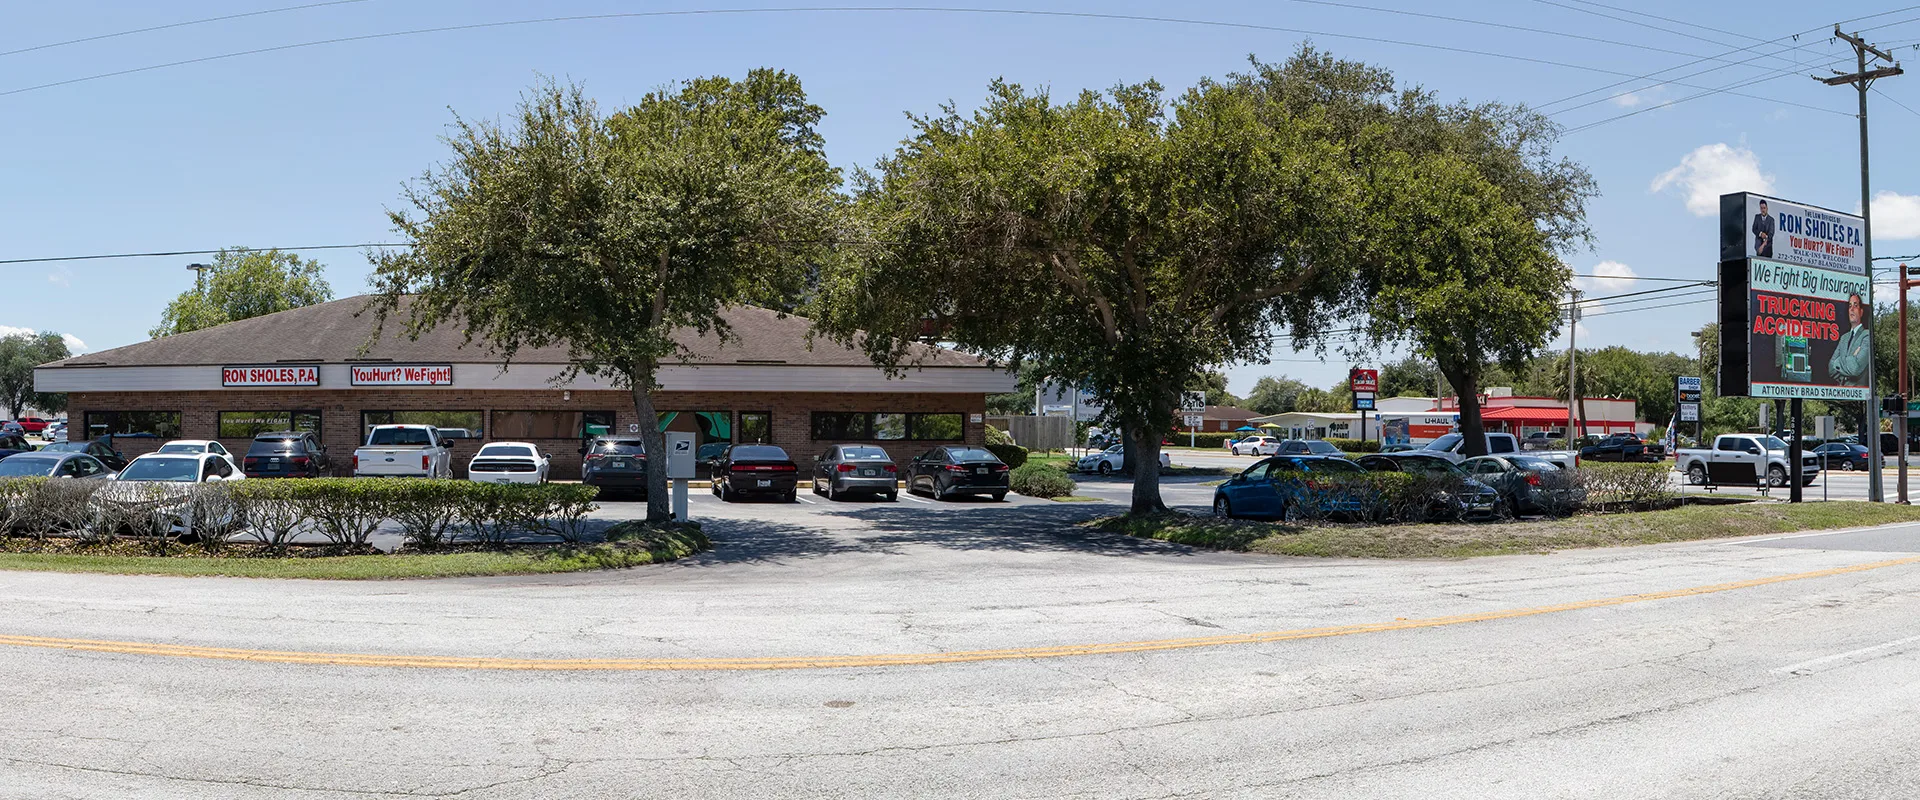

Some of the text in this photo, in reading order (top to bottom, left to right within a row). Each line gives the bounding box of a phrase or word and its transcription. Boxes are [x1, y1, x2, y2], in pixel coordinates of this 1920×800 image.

[1780, 212, 1863, 247] RON SHOLES P.A.
[1789, 235, 1855, 258] YOU HURT? WE FIGHT!
[1793, 248, 1850, 264] WALK-INS WELCOME
[1818, 258, 1847, 270] BLANDING
[1848, 264, 1862, 272] BLVD
[1754, 263, 1868, 297] We Fight Big Insurance!
[1757, 294, 1836, 321] TRUCKING
[1753, 315, 1839, 342] ACCIDENTS
[223, 368, 319, 385] RON SHOLES, P.A.
[353, 367, 451, 385] YouHurt? WeFight!
[1679, 377, 1700, 386] BARBER
[1761, 385, 1863, 398] ATTORNEY BRAD STACKHOUSE
